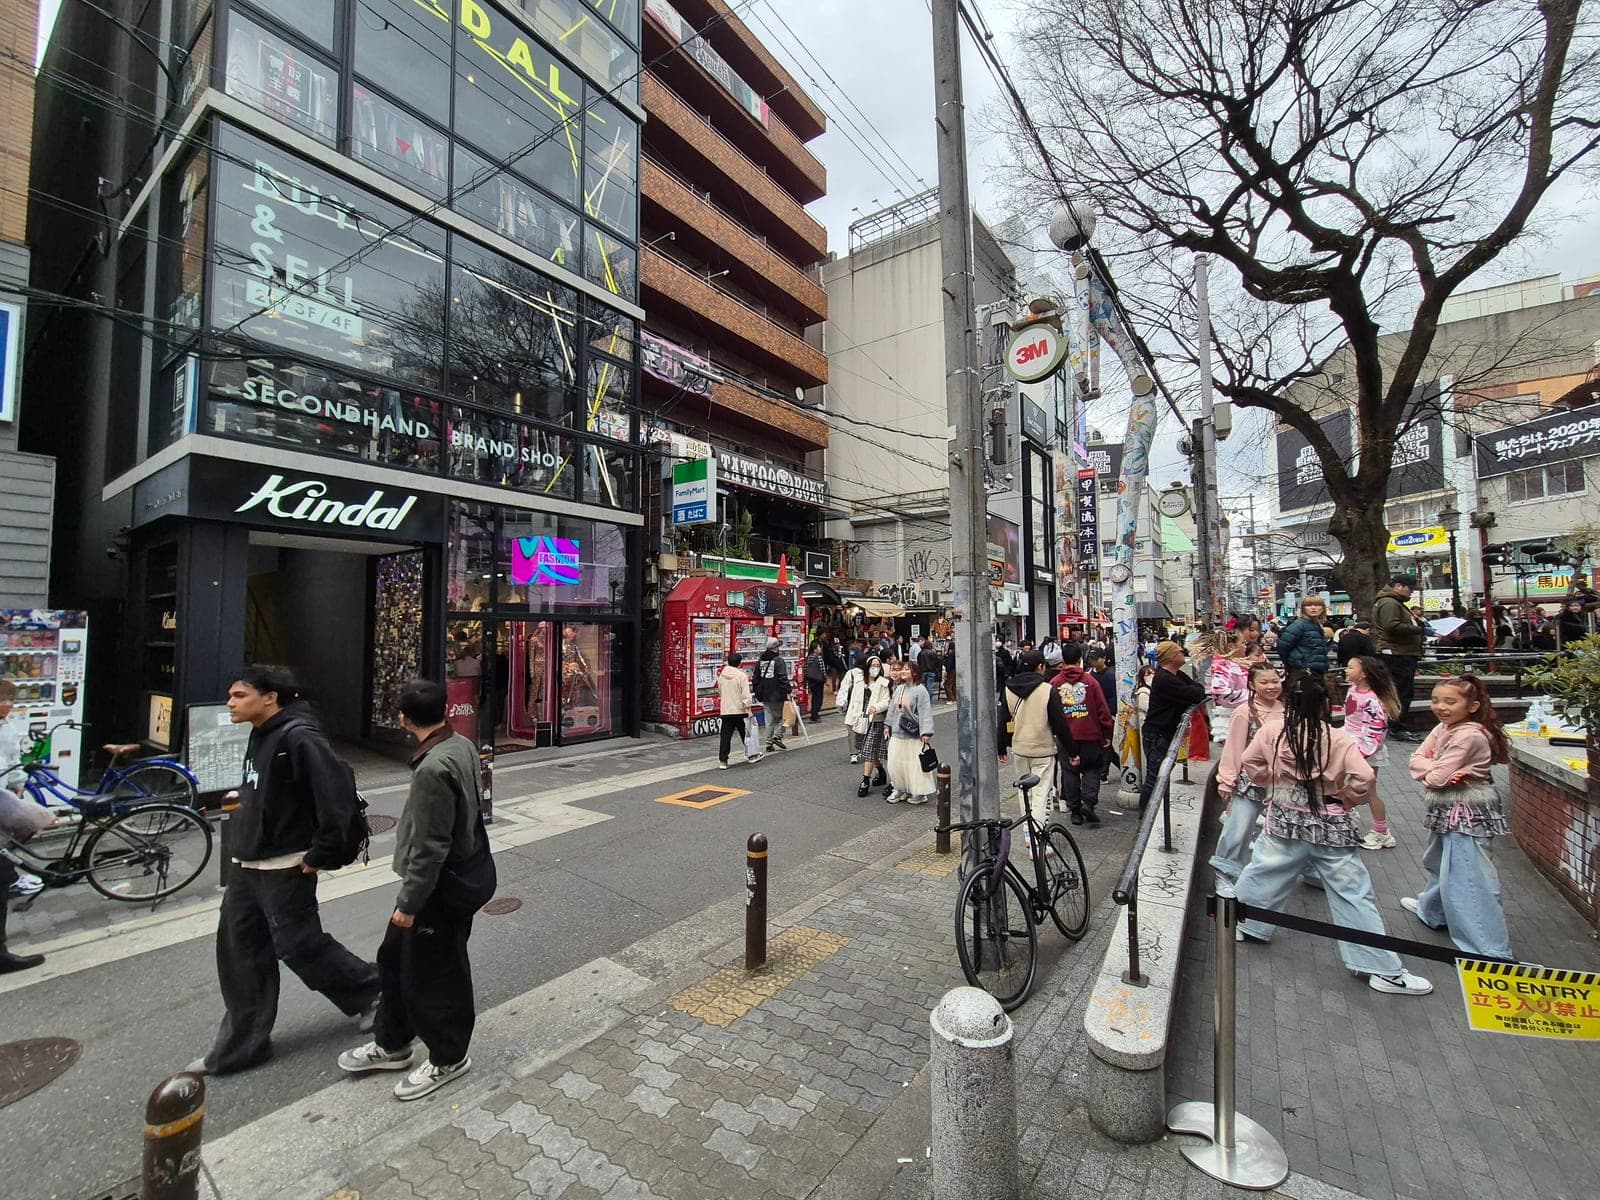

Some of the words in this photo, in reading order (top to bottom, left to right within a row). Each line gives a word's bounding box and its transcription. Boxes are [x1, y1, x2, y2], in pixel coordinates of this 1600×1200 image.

[432, 0, 578, 106] DAL
[254, 159, 351, 230] BUY
[251, 203, 285, 245] &
[248, 241, 361, 316] SELL
[1016, 338, 1049, 366] 3M
[242, 380, 430, 439] SECONDHAND
[450, 430, 516, 459] BRAND
[521, 447, 565, 468] SHOP
[720, 453, 778, 490] TATTOO
[234, 474, 418, 530] Kindal
[675, 486, 706, 497] FamilyMart
[687, 508, 704, 519] たばこ
[539, 553, 577, 565] FASHION
[1472, 992, 1600, 1018] 立ち入り禁止
[1477, 977, 1509, 992] NO
[1516, 981, 1591, 1001] ENTRY
